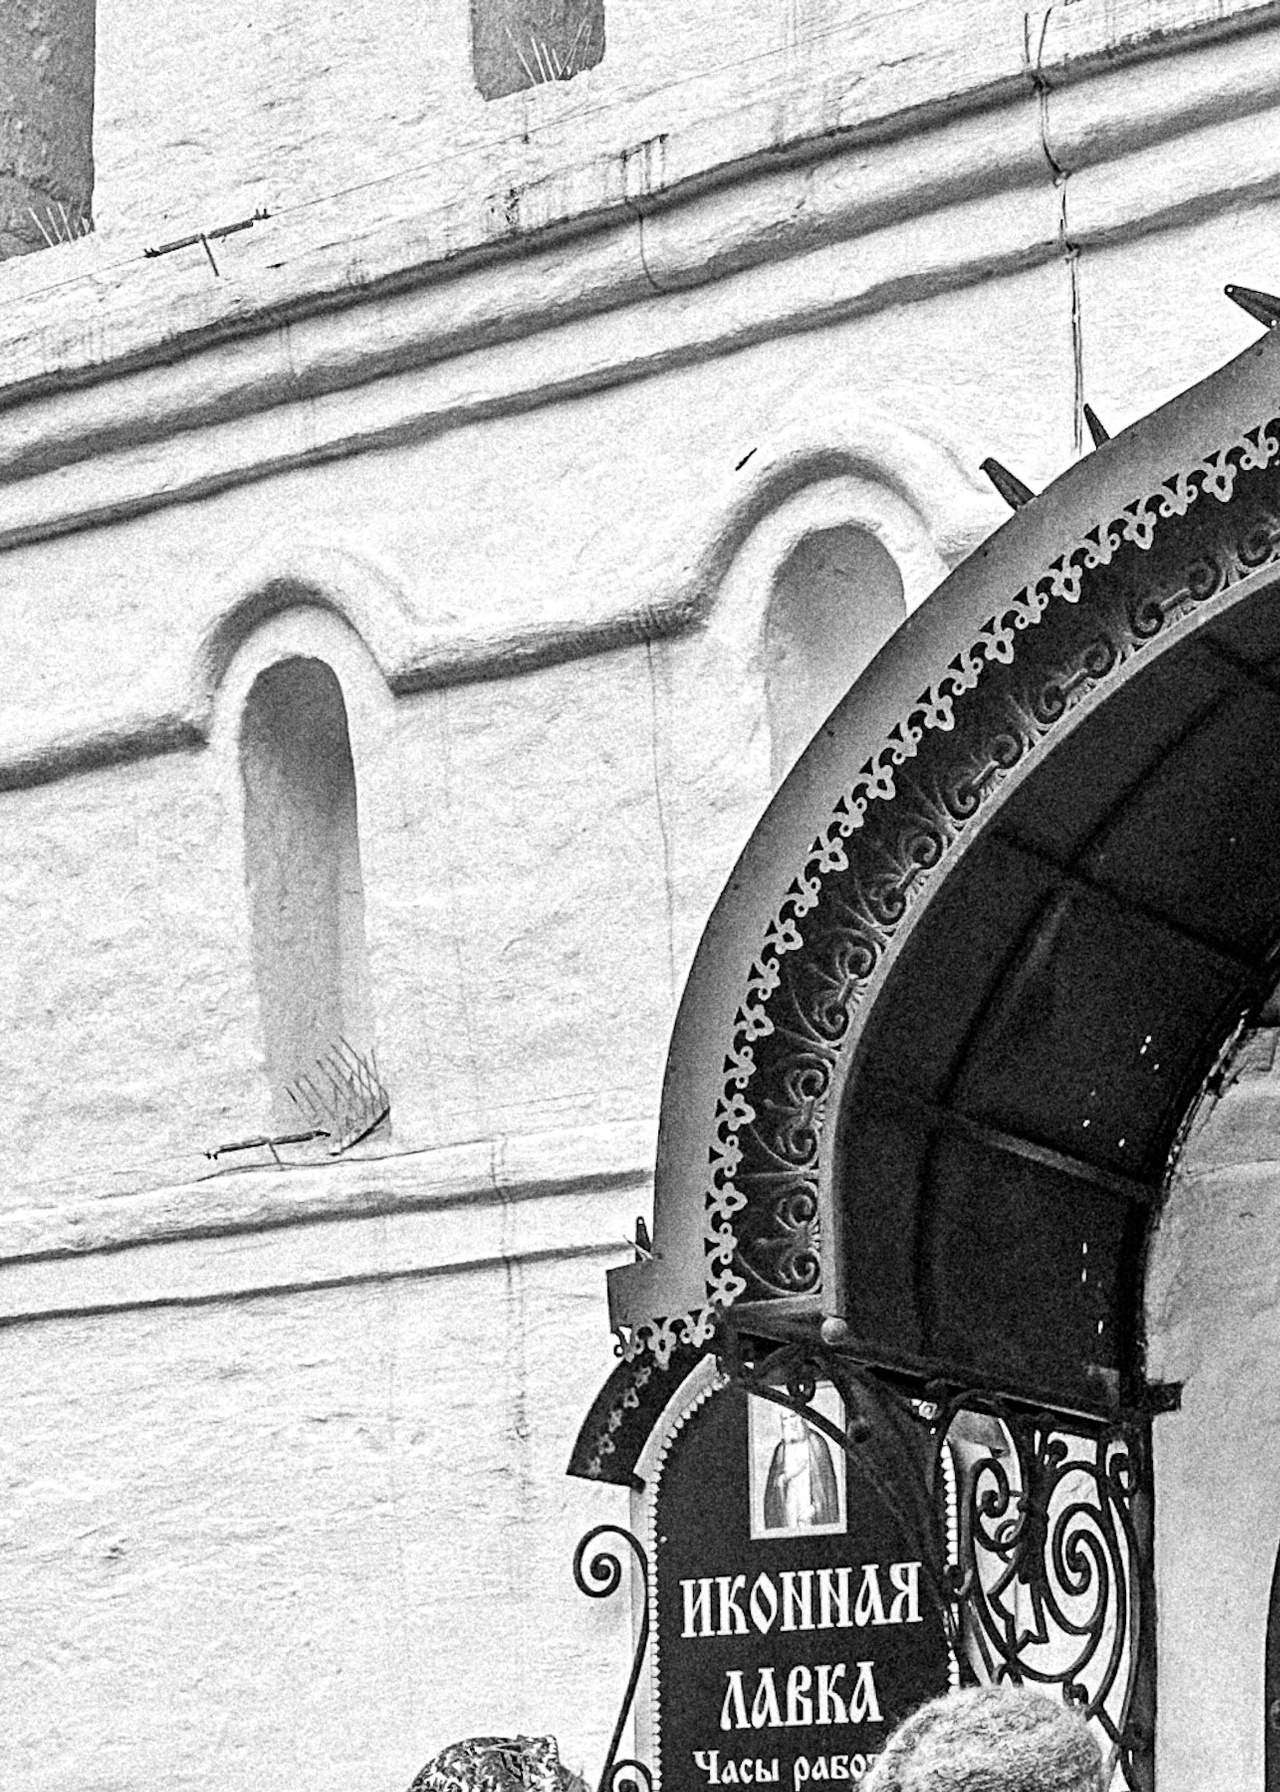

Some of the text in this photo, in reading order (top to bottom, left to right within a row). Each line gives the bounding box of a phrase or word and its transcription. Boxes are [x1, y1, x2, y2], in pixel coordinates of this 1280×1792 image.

[679, 1561, 923, 1638] ИКОННАЯ
[720, 1661, 884, 1731] ЛАВКА
[692, 1750, 780, 1784] Часы
